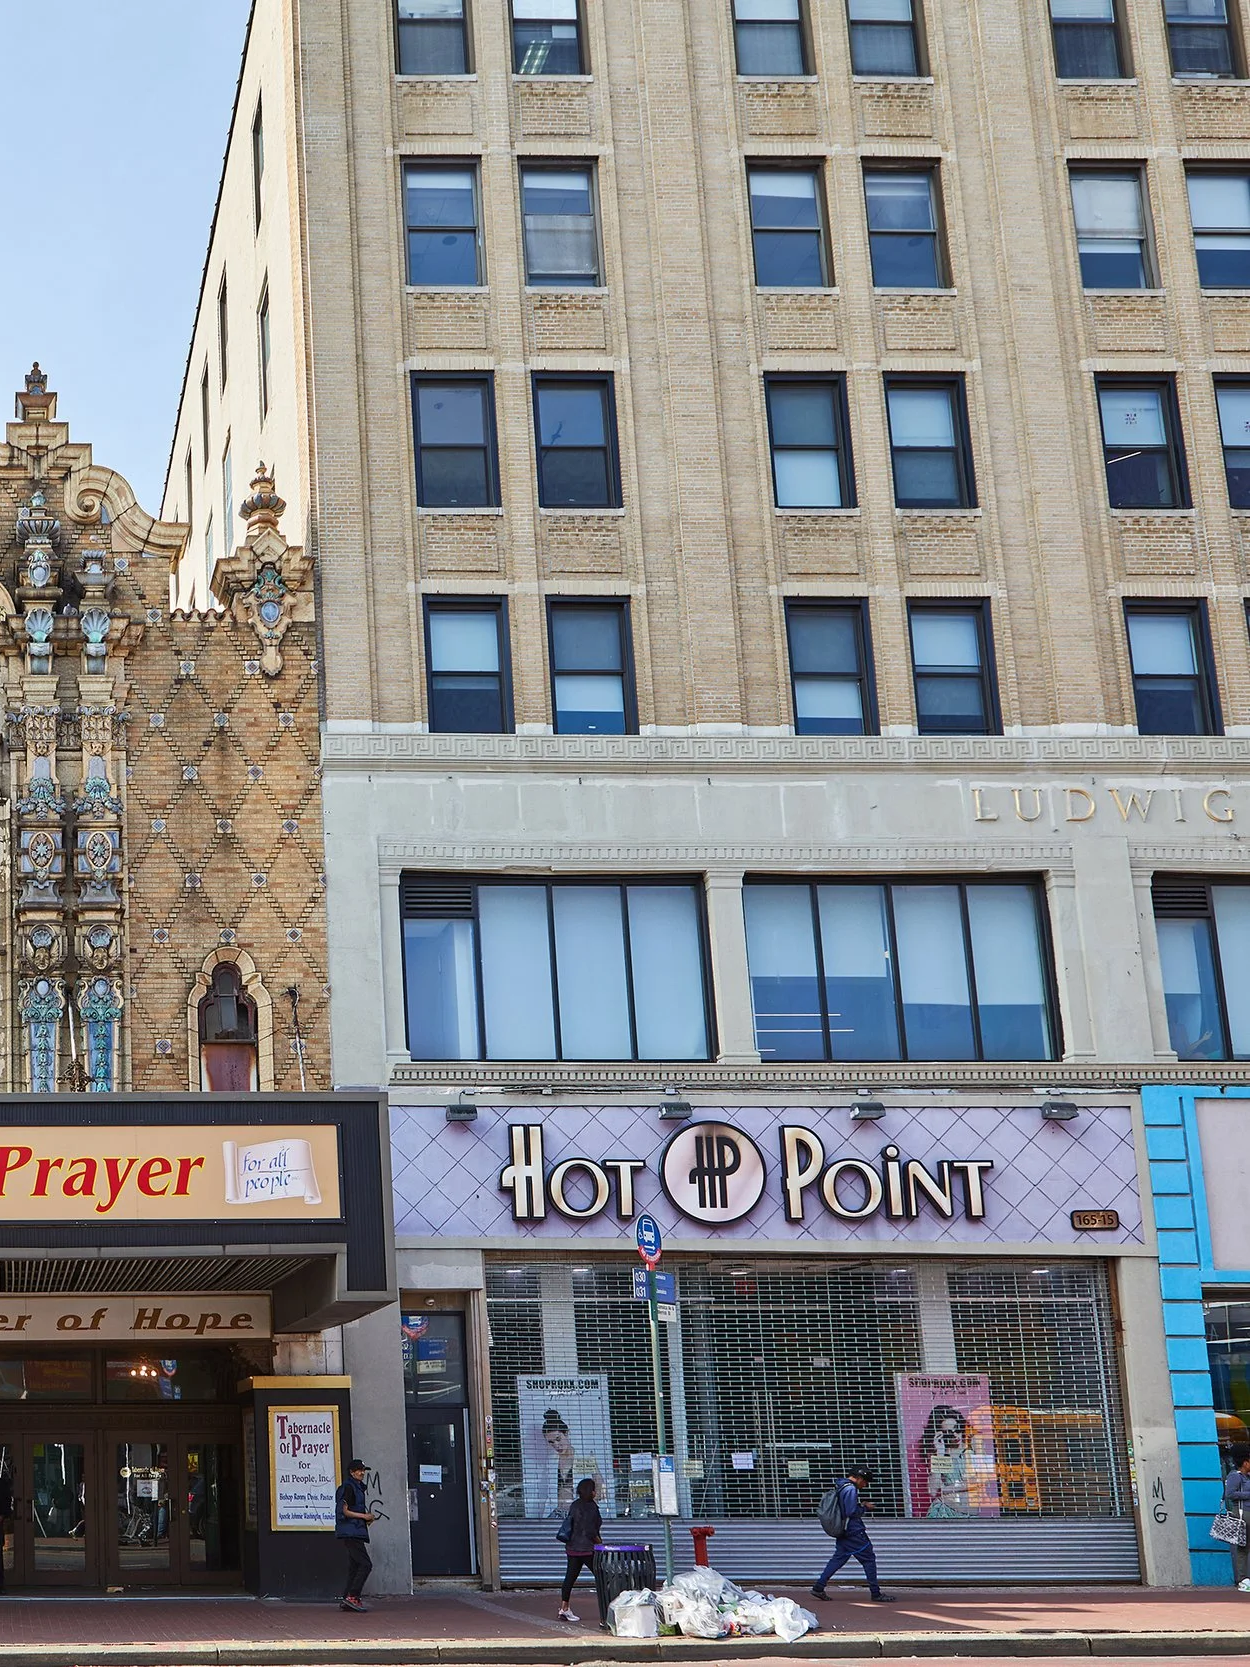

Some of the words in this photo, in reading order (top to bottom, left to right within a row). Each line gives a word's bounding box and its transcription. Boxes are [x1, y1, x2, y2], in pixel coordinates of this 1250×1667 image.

[971, 788, 1235, 822] LUDWIG
[240, 1151, 265, 1176] for
[269, 1147, 290, 1169] all
[1075, 1214, 1115, 1226] 165-15
[56, 1307, 108, 1331] of
[130, 1307, 254, 1335] Hope
[277, 1415, 331, 1439] Tabernacle
[280, 1443, 290, 1454] Of
[291, 1434, 330, 1457] Prayer
[299, 1460, 311, 1470] for
[280, 1475, 290, 1483] All
